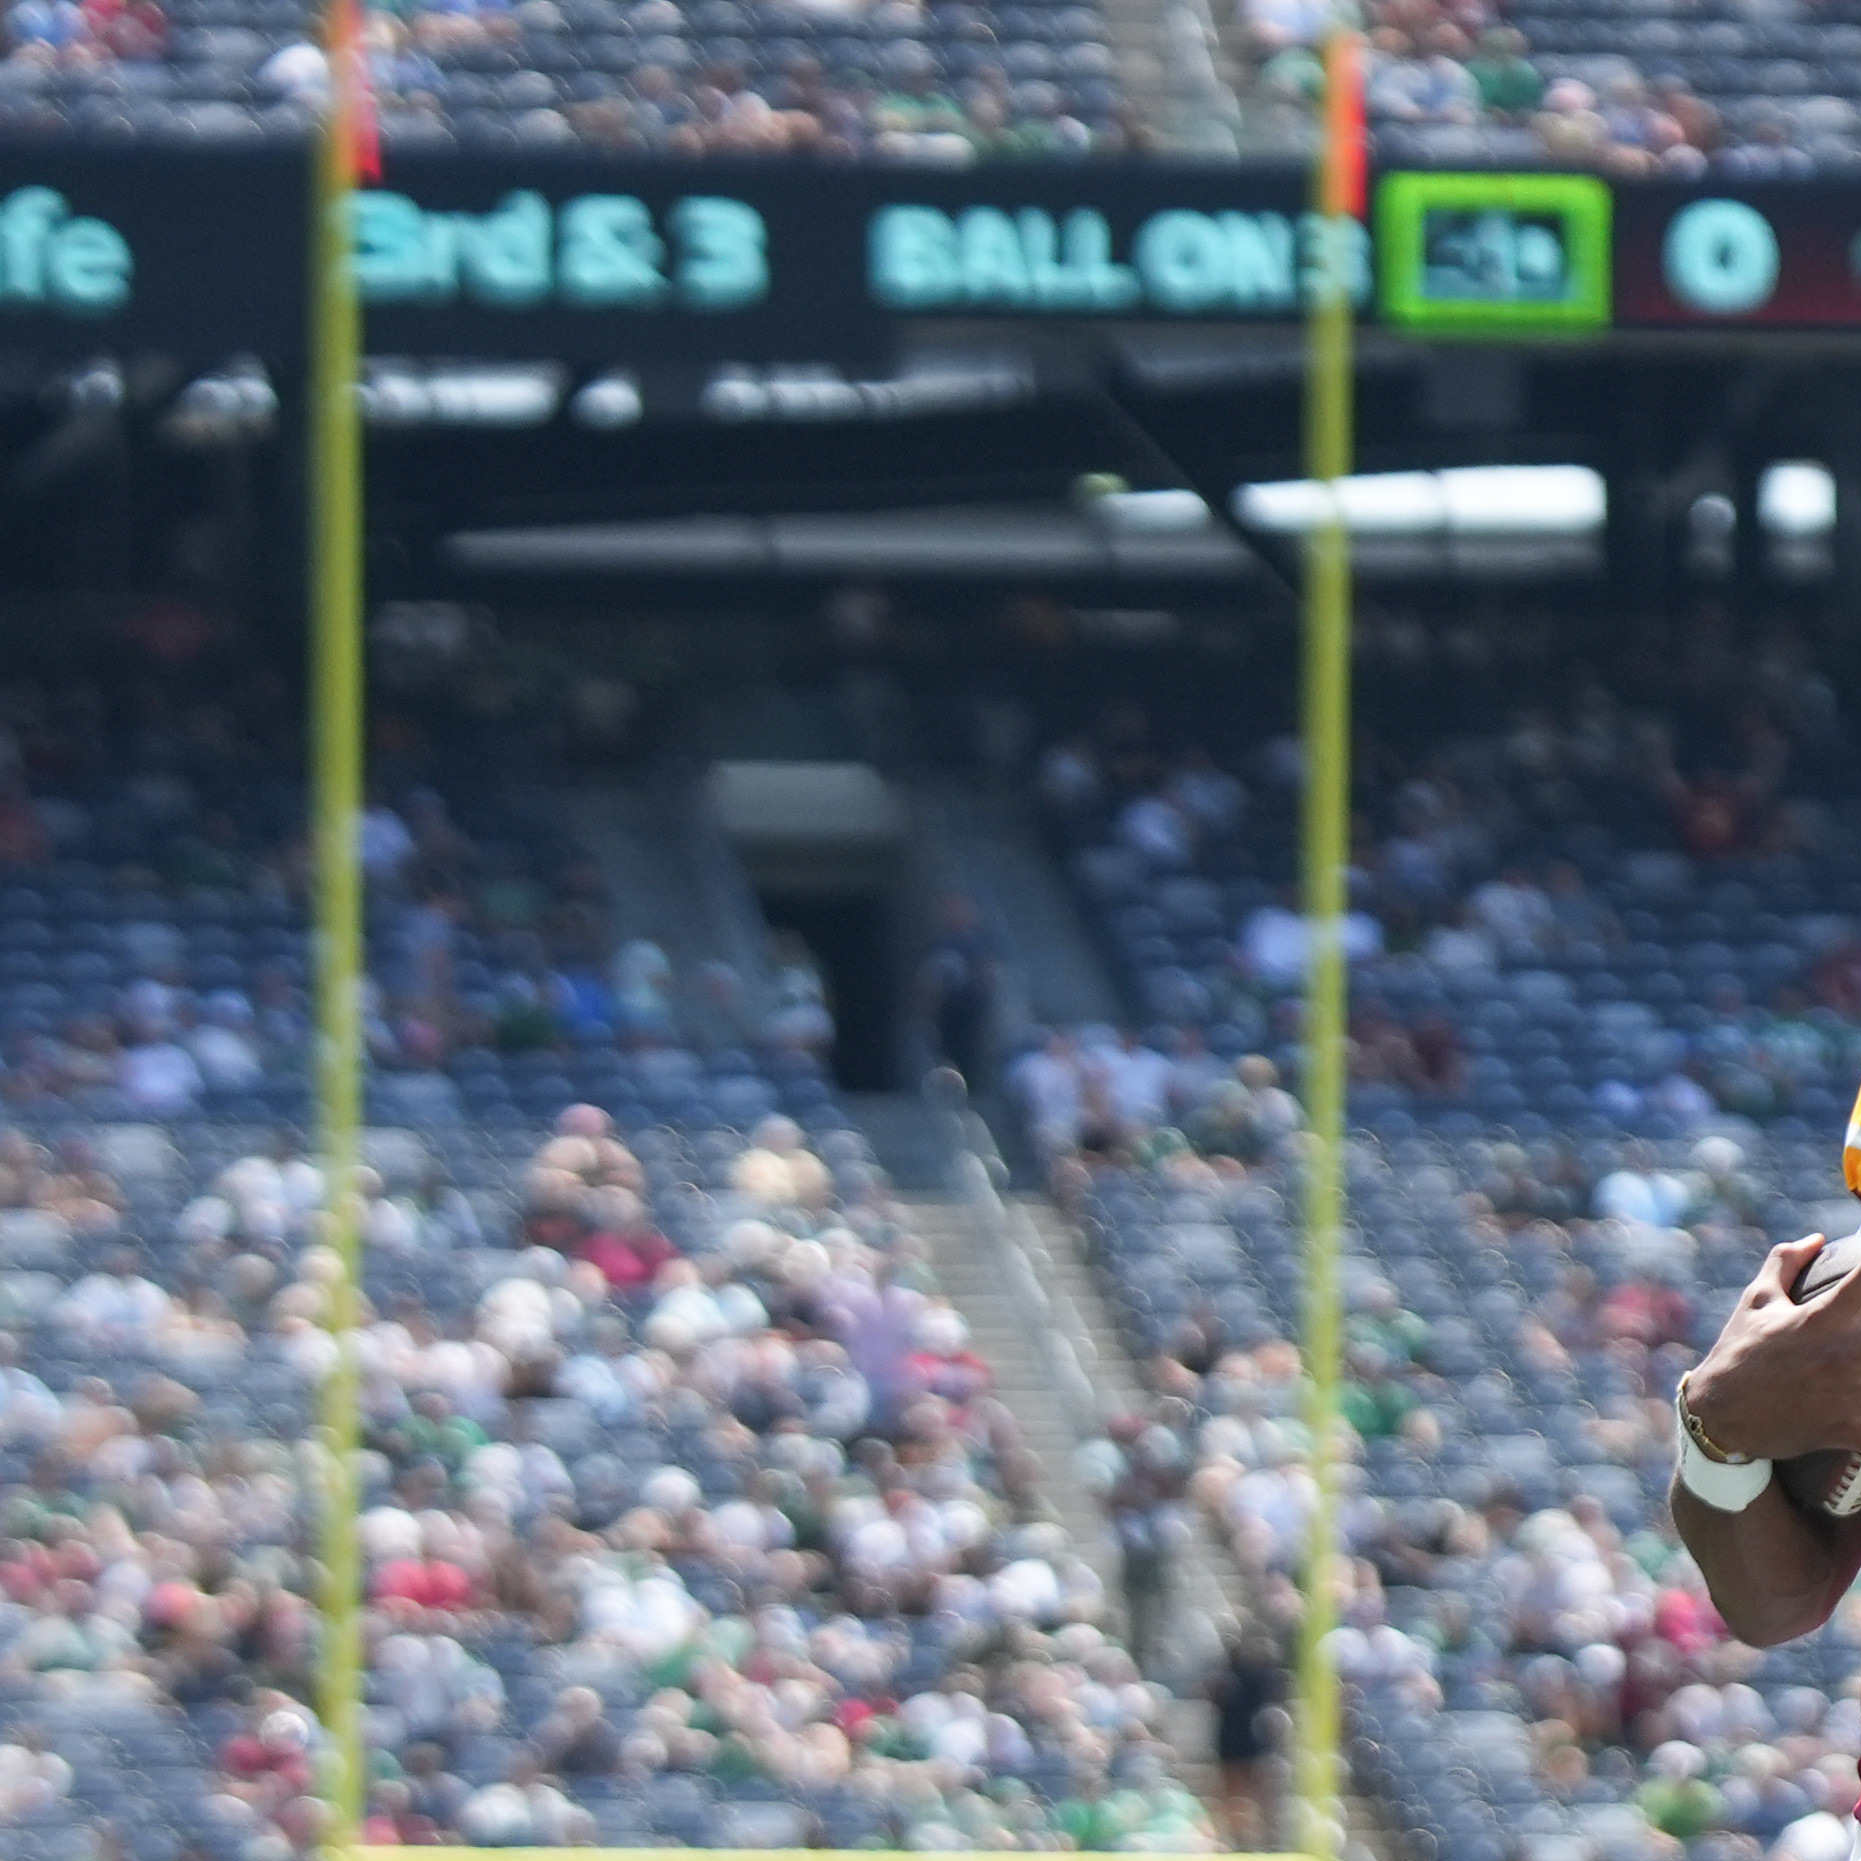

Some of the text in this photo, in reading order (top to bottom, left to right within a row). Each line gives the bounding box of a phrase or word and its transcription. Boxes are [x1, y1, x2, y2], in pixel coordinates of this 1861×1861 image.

[676, 197, 768, 306] 3
[868, 206, 1140, 308] BALL
[1134, 209, 1294, 309] ON
